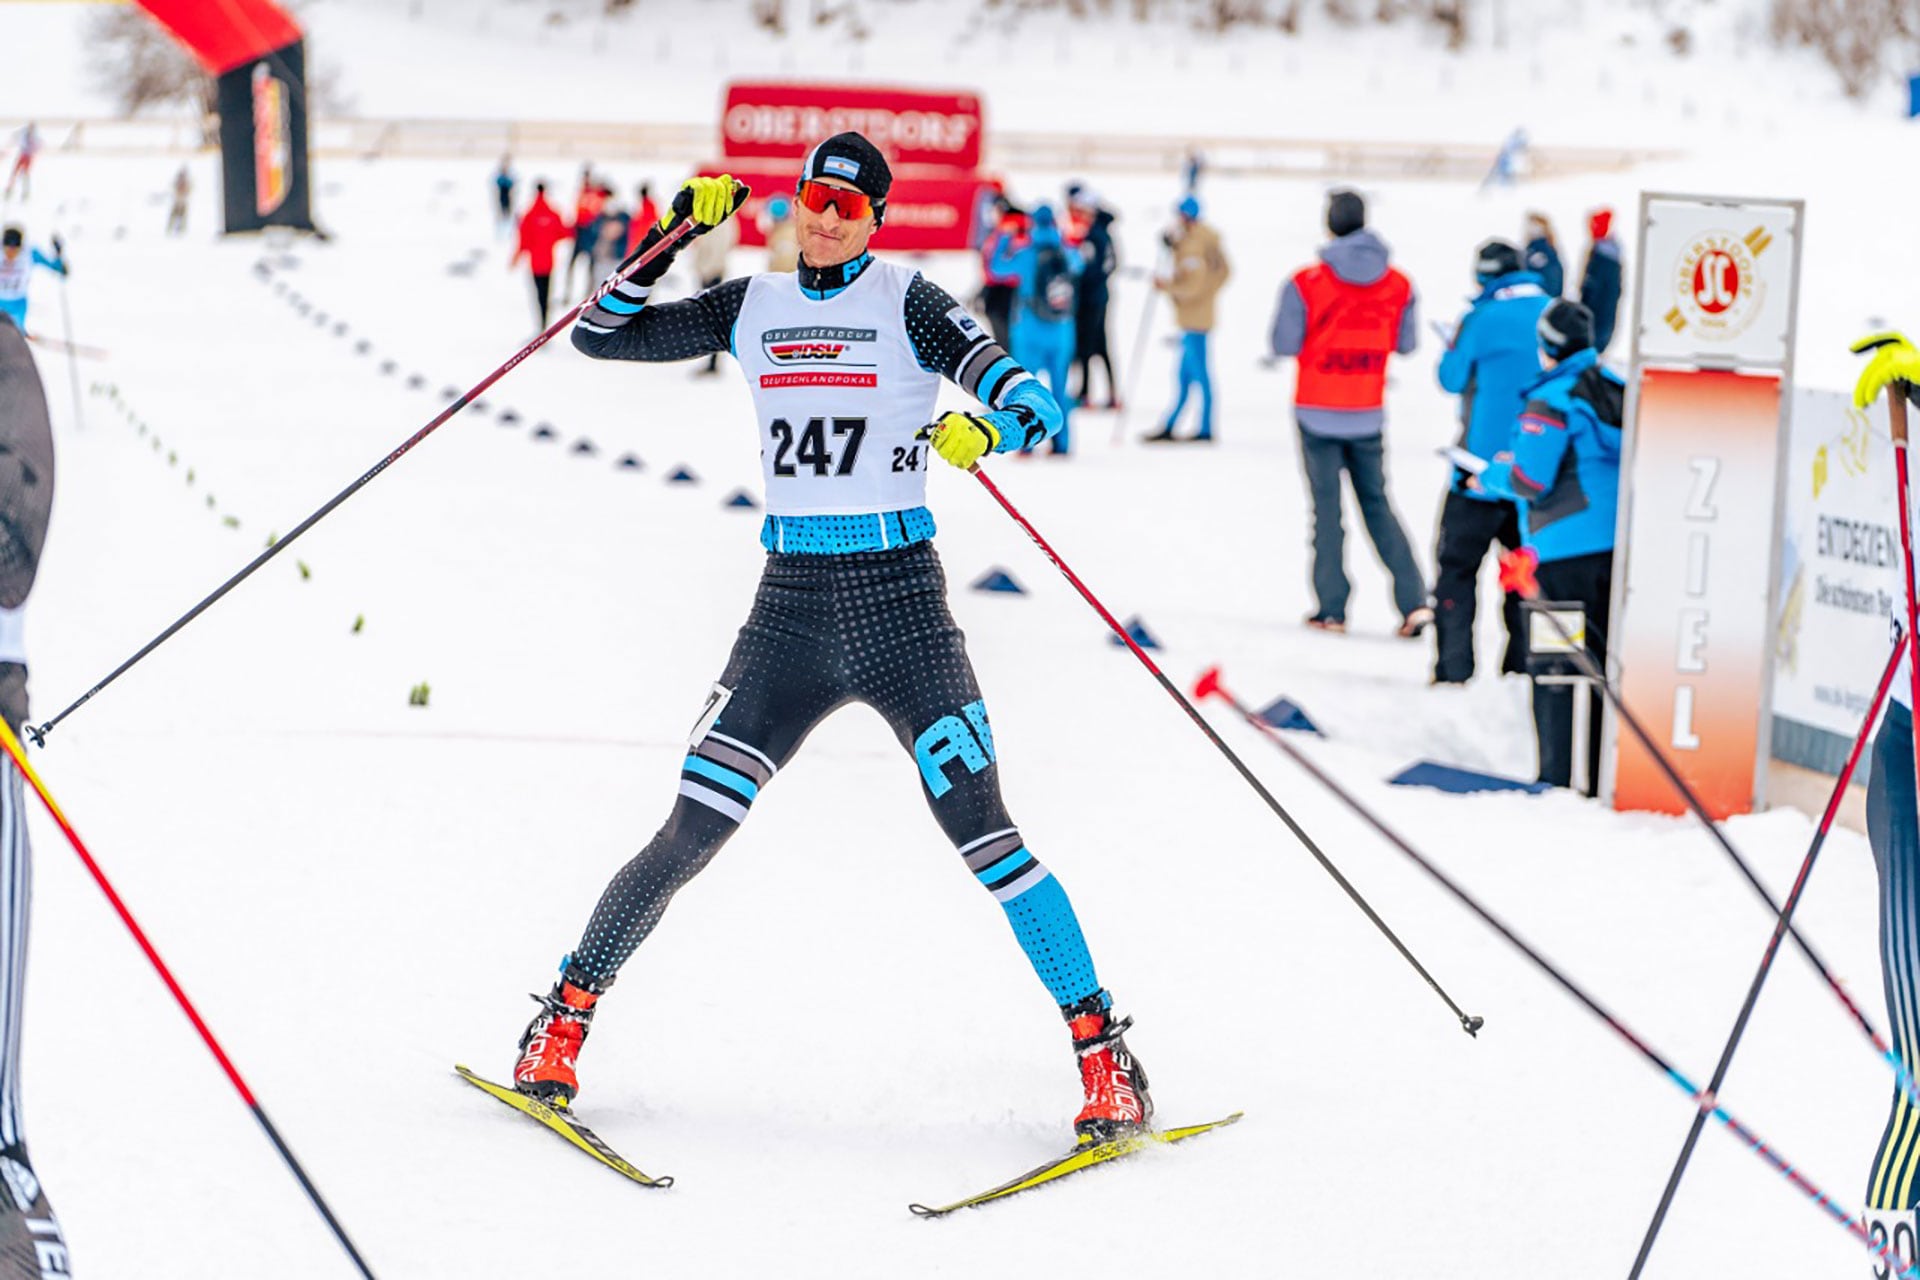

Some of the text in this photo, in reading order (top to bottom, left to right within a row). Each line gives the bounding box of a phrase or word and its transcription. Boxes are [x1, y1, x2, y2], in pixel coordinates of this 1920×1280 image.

[765, 328, 873, 341] DSV JUGENDCUP
[763, 374, 873, 386] DEUTSCHLANDPOKAL
[770, 416, 868, 478] 247
[24, 1210, 72, 1280] TE
